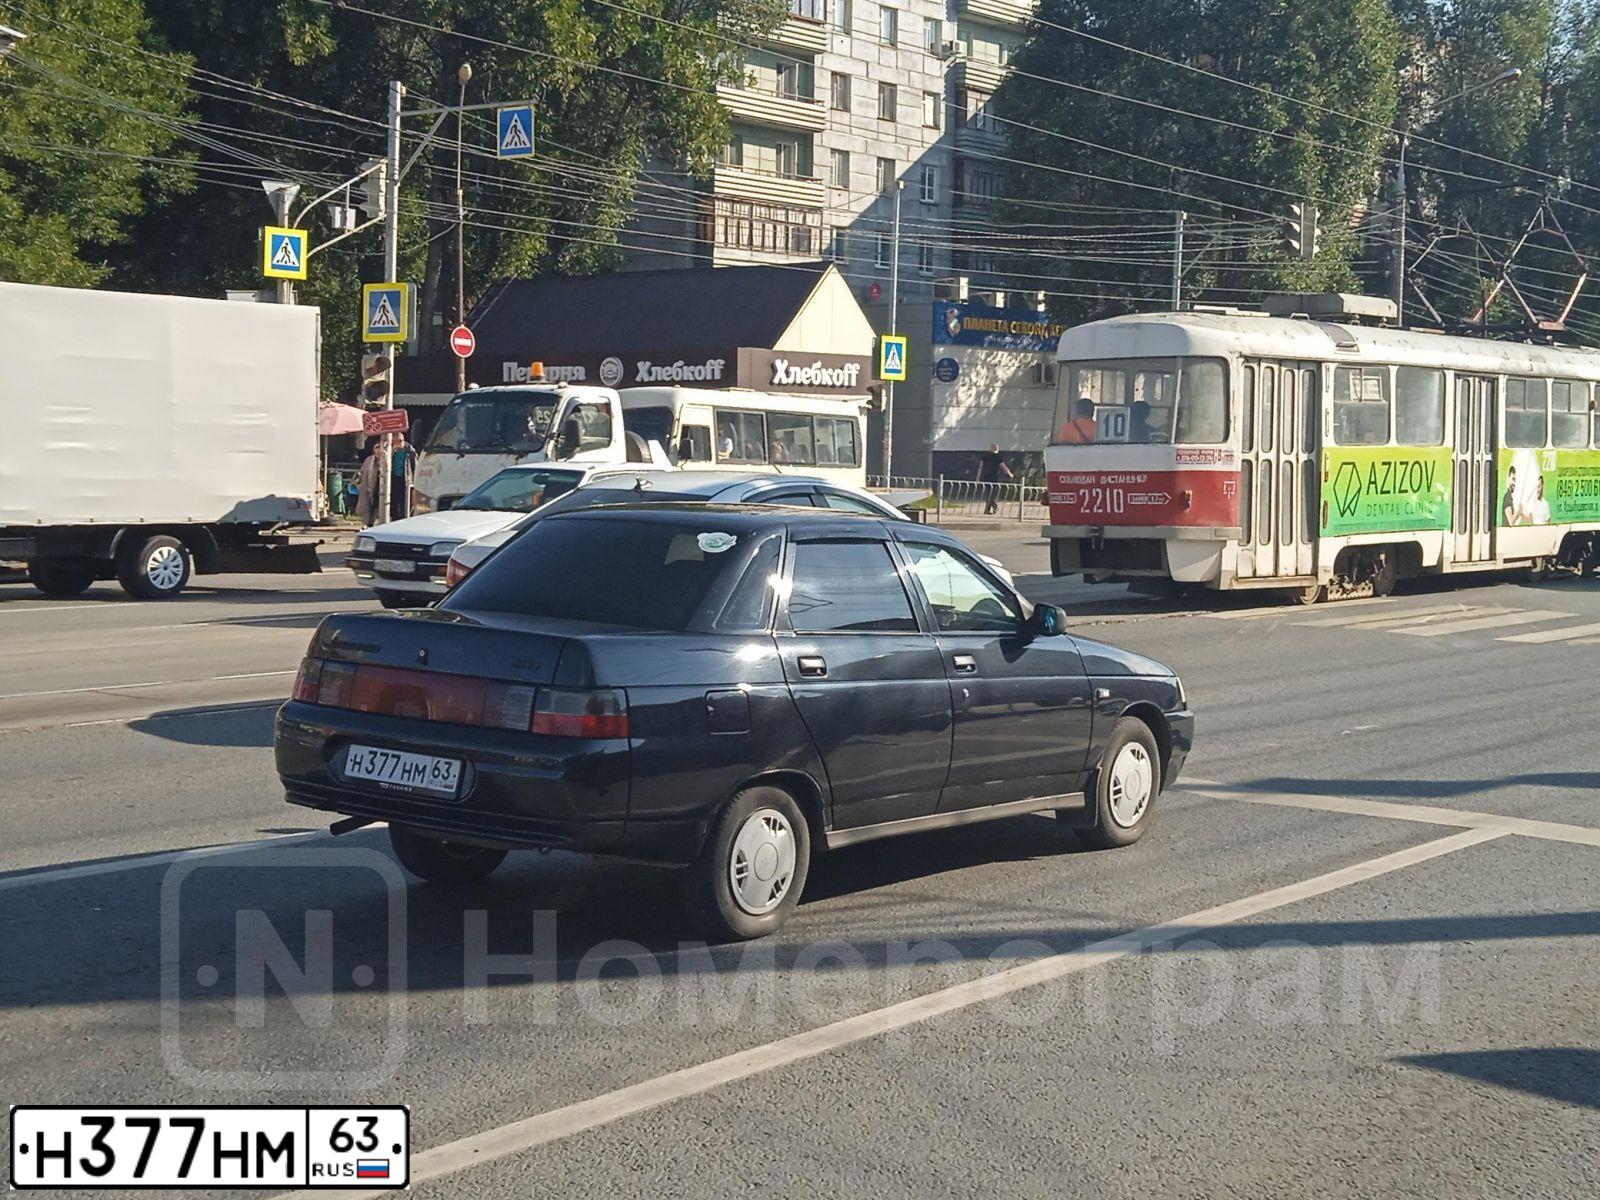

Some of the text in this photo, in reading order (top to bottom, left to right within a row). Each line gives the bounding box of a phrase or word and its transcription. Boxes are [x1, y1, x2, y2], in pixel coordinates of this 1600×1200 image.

[503, 361, 586, 383] Перня
[635, 359, 726, 382] Хлебкоff
[773, 358, 861, 387] Хлебкоff
[1103, 412, 1126, 438] 10
[1366, 460, 1436, 495] AZIZOV
[1079, 488, 1125, 513] 2210
[1366, 502, 1400, 517] DENTAL
[350, 751, 453, 785] Н377НМ 63
